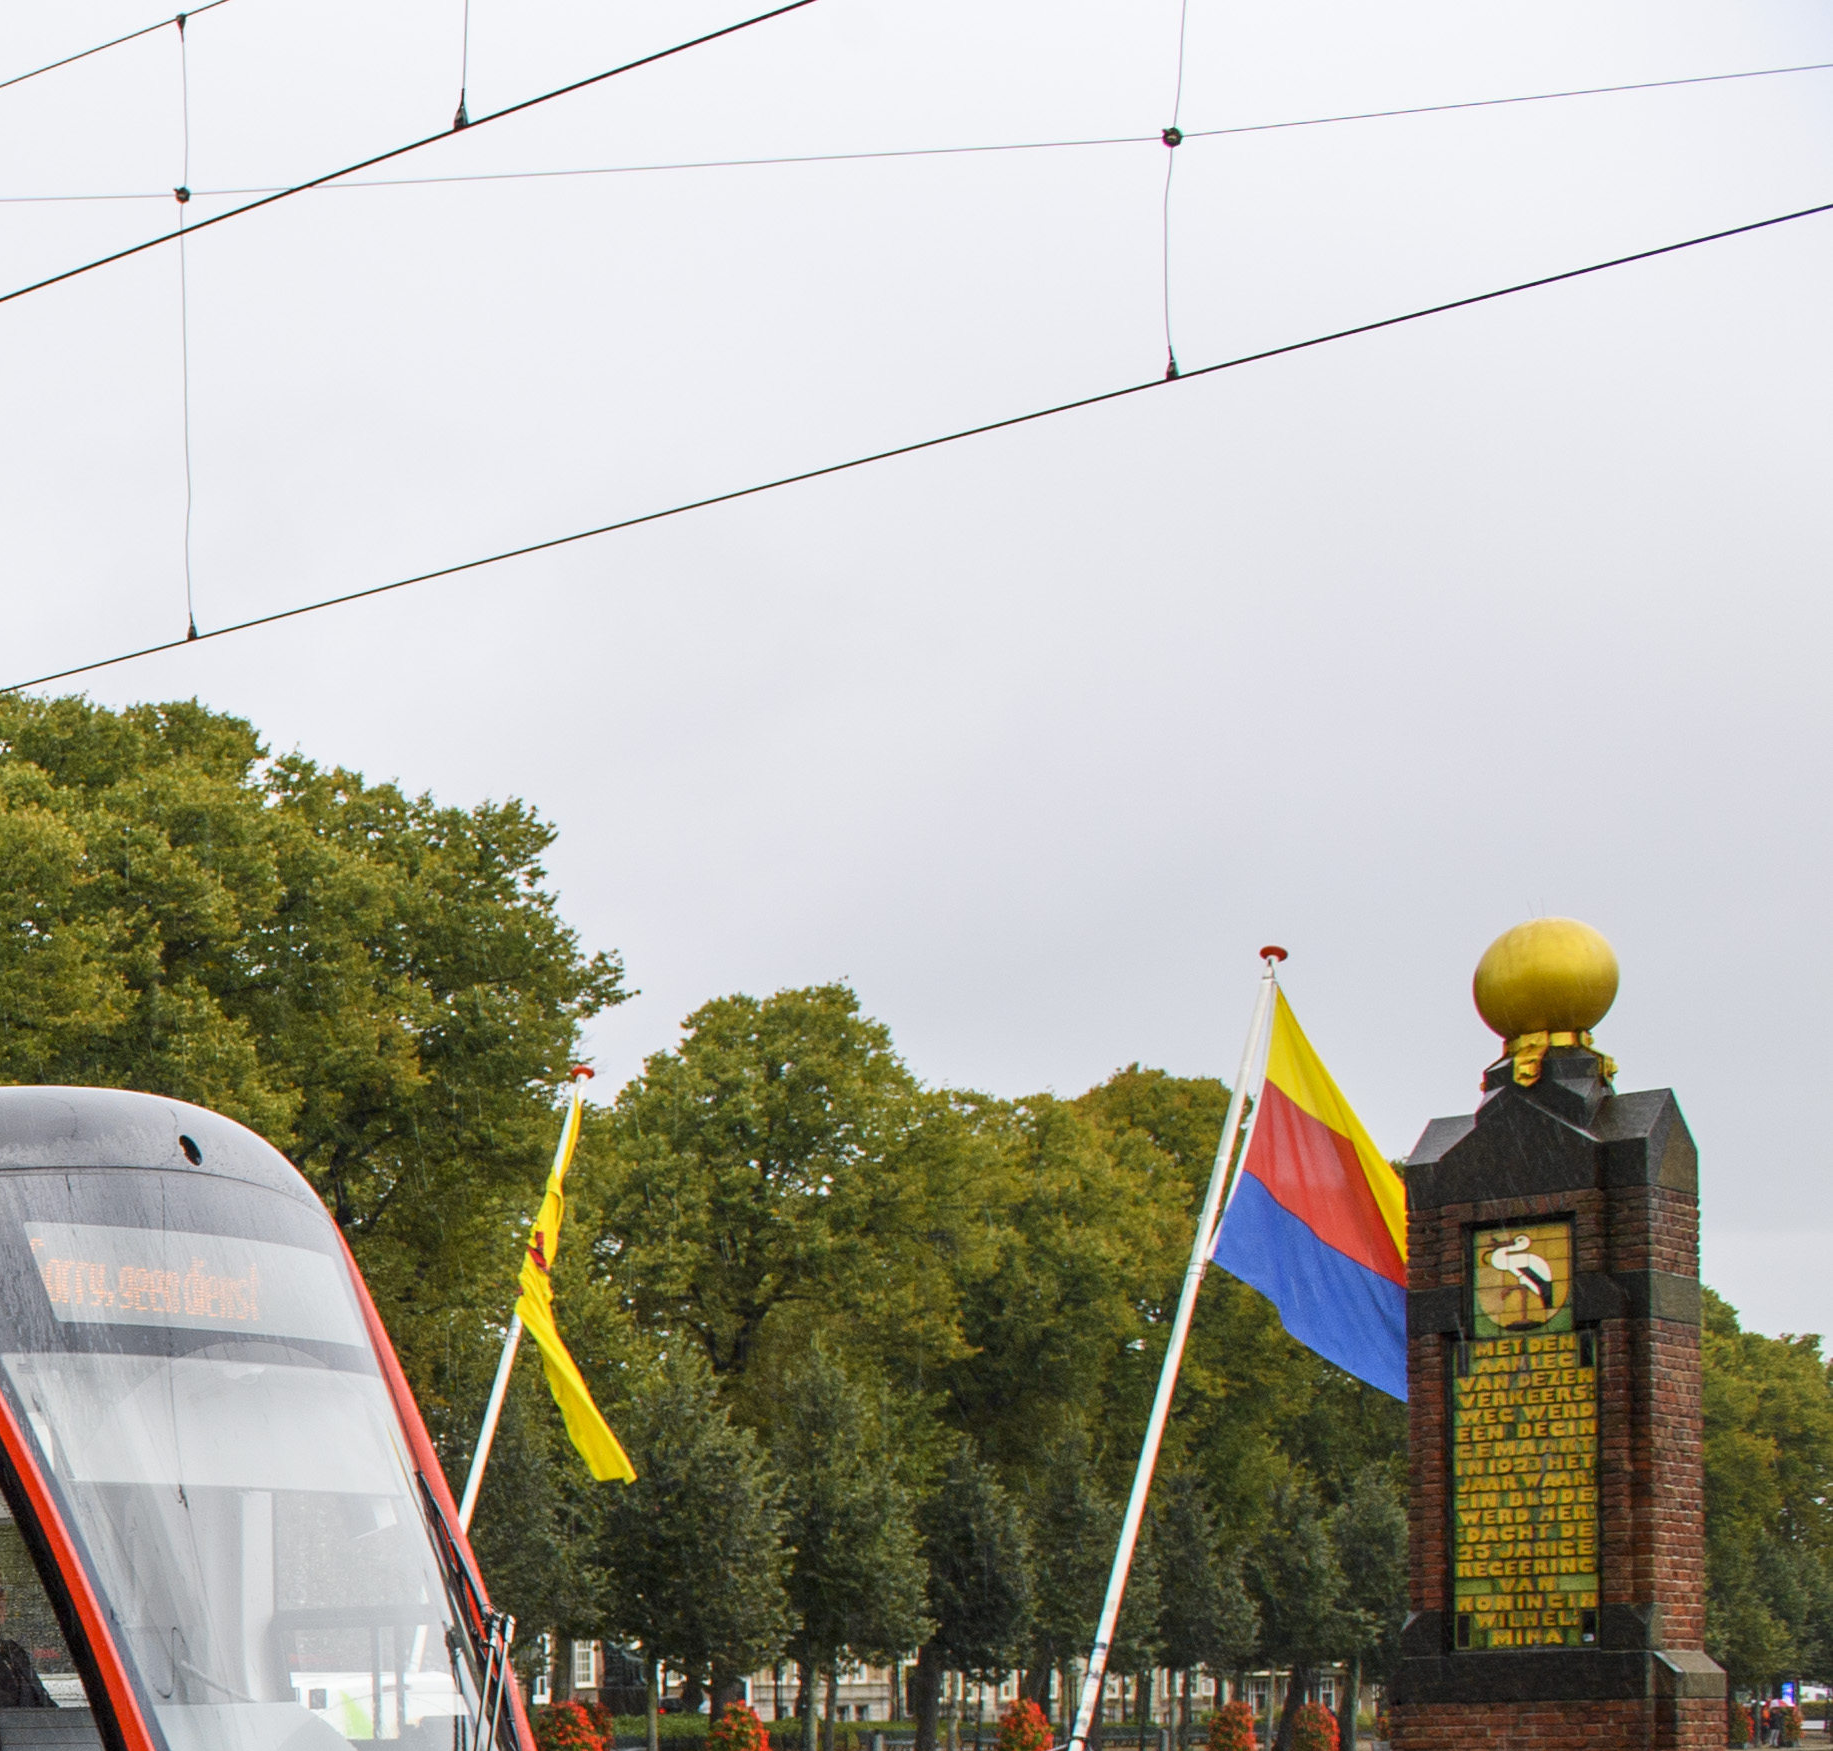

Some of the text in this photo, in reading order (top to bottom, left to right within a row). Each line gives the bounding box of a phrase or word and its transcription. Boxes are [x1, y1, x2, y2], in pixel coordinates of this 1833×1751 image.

[1474, 1335, 1575, 1357] MET DEN
[1458, 1367, 1595, 1392] VAN DEZEN
[1458, 1403, 1594, 1425] WEG WERD
[1456, 1419, 1596, 1442] EEN BEGIN
[1456, 1437, 1594, 1459] GEMAAKT
[1456, 1461, 1484, 1476] IN
[1547, 1453, 1595, 1470] HET
[1458, 1475, 1517, 1493] JAAR
[1458, 1508, 1530, 1525] WERD
[1561, 1521, 1594, 1538] DE
[1457, 1557, 1595, 1577] REGEERING
[1498, 1575, 1555, 1593] VAN
[1458, 1592, 1597, 1612] KONINGIN
[1492, 1628, 1563, 1645] MINA
